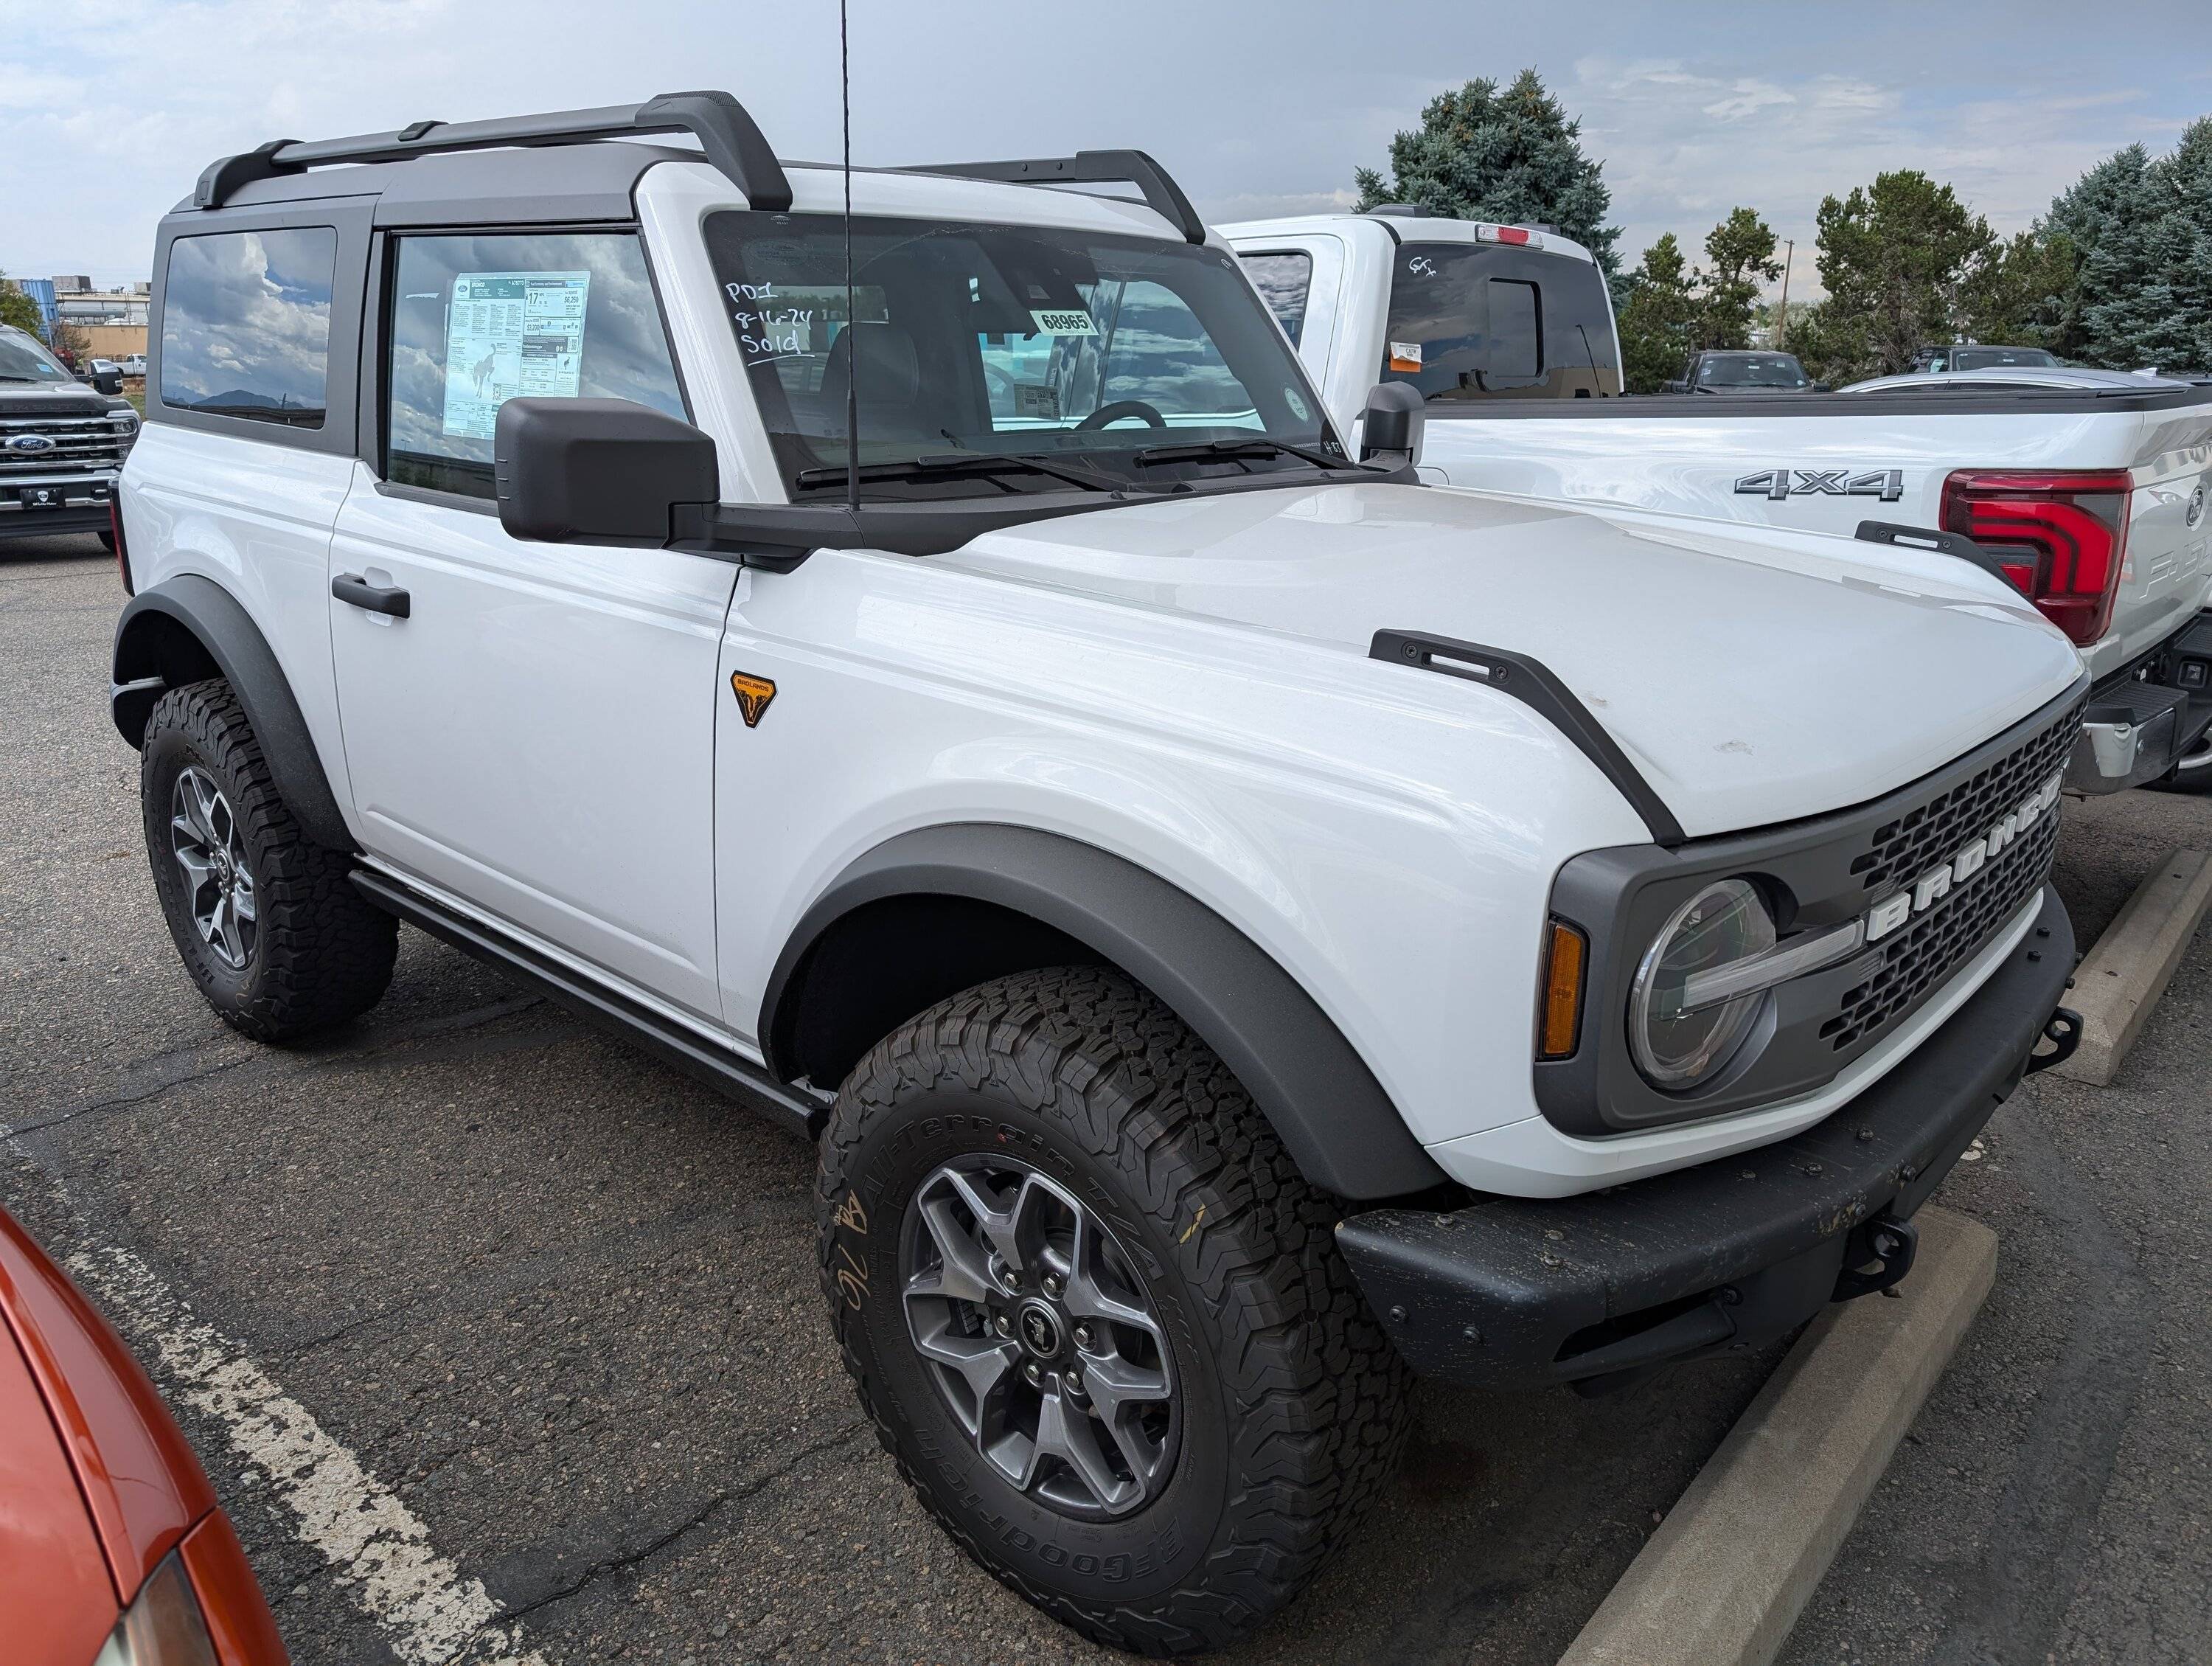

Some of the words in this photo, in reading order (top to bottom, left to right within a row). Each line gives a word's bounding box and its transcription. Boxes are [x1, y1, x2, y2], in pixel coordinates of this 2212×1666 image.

[529, 292, 538, 305] 17
[1041, 313, 1089, 330] 68965
[741, 330, 801, 354] Sold
[21, 440, 44, 450] Ford
[737, 678, 769, 693] BADLANDS
[1866, 768, 2064, 942] BRONCO
